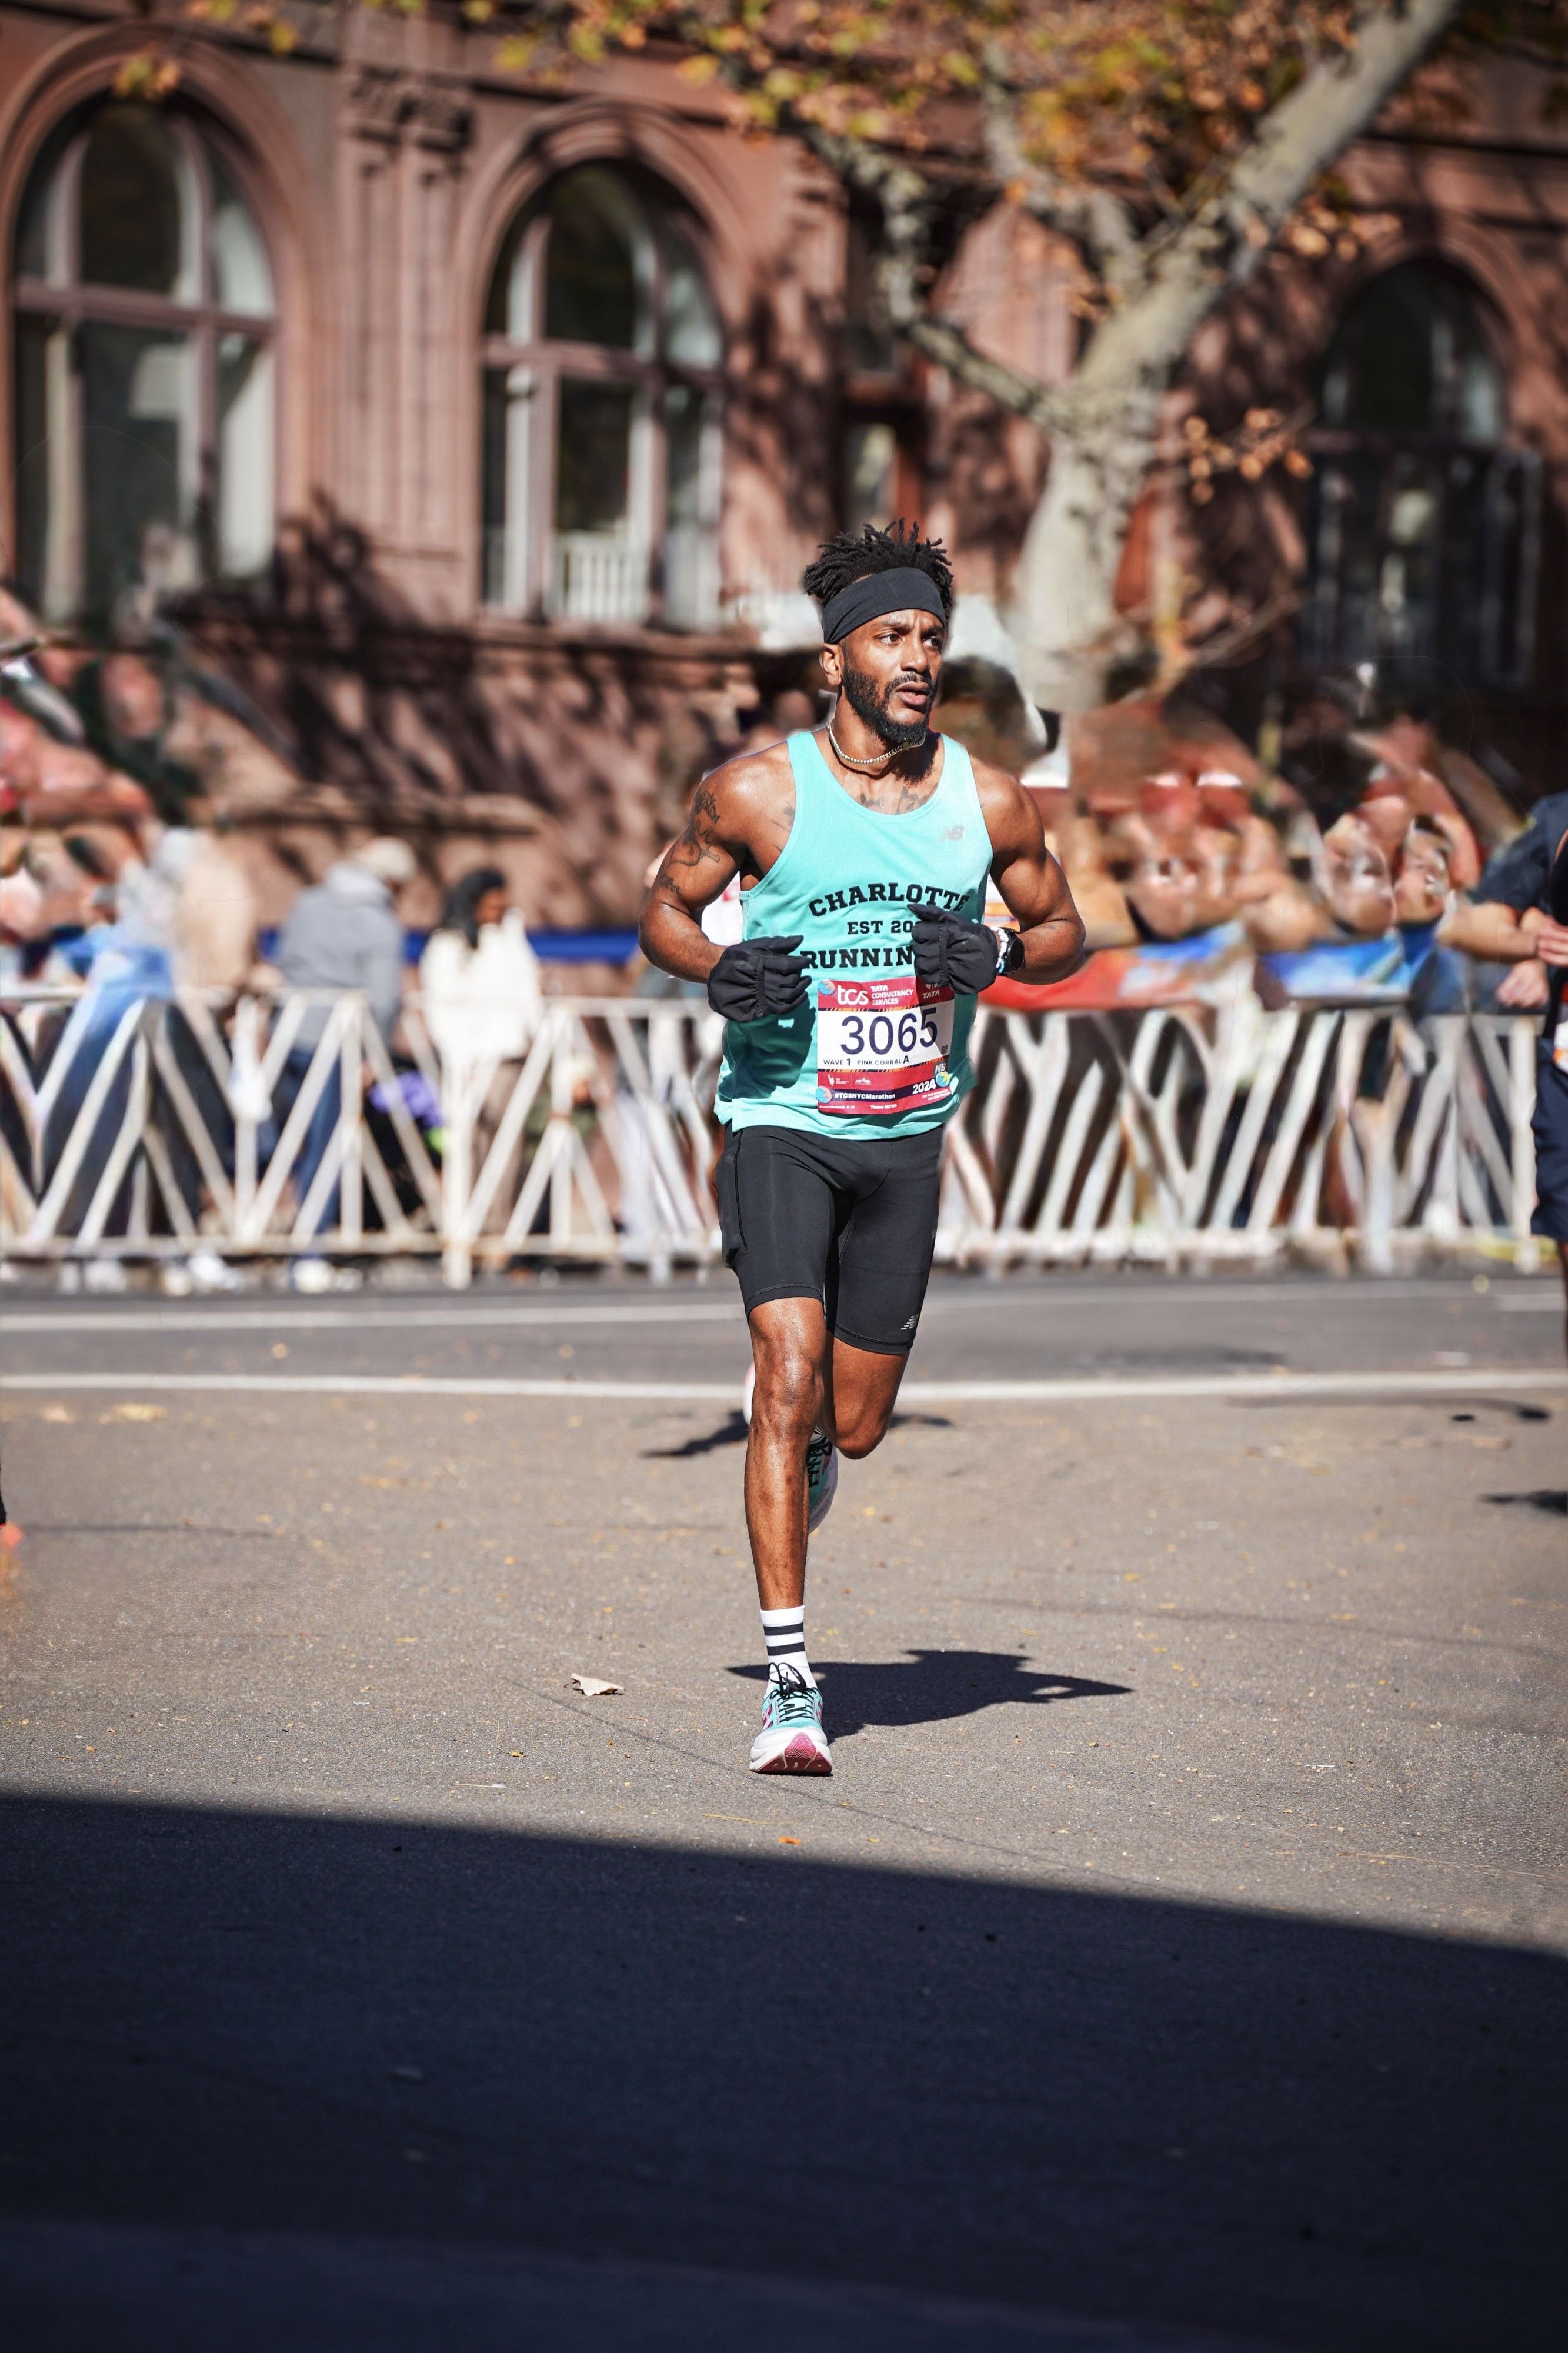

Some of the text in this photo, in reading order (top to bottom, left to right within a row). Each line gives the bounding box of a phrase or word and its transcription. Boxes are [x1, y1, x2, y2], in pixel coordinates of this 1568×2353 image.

[809, 882, 970, 917] CHARLOTTE
[847, 920, 922, 934] EST 20
[800, 945, 913, 969] RUNNIN
[837, 984, 869, 1005] tcs
[871, 989, 913, 999] CONSULTANCY
[922, 989, 940, 999] TATA
[872, 998, 899, 1006] SERVICES
[840, 1007, 938, 1055] 3065
[903, 1055, 909, 1064] A
[912, 1079, 936, 1094] 2024
